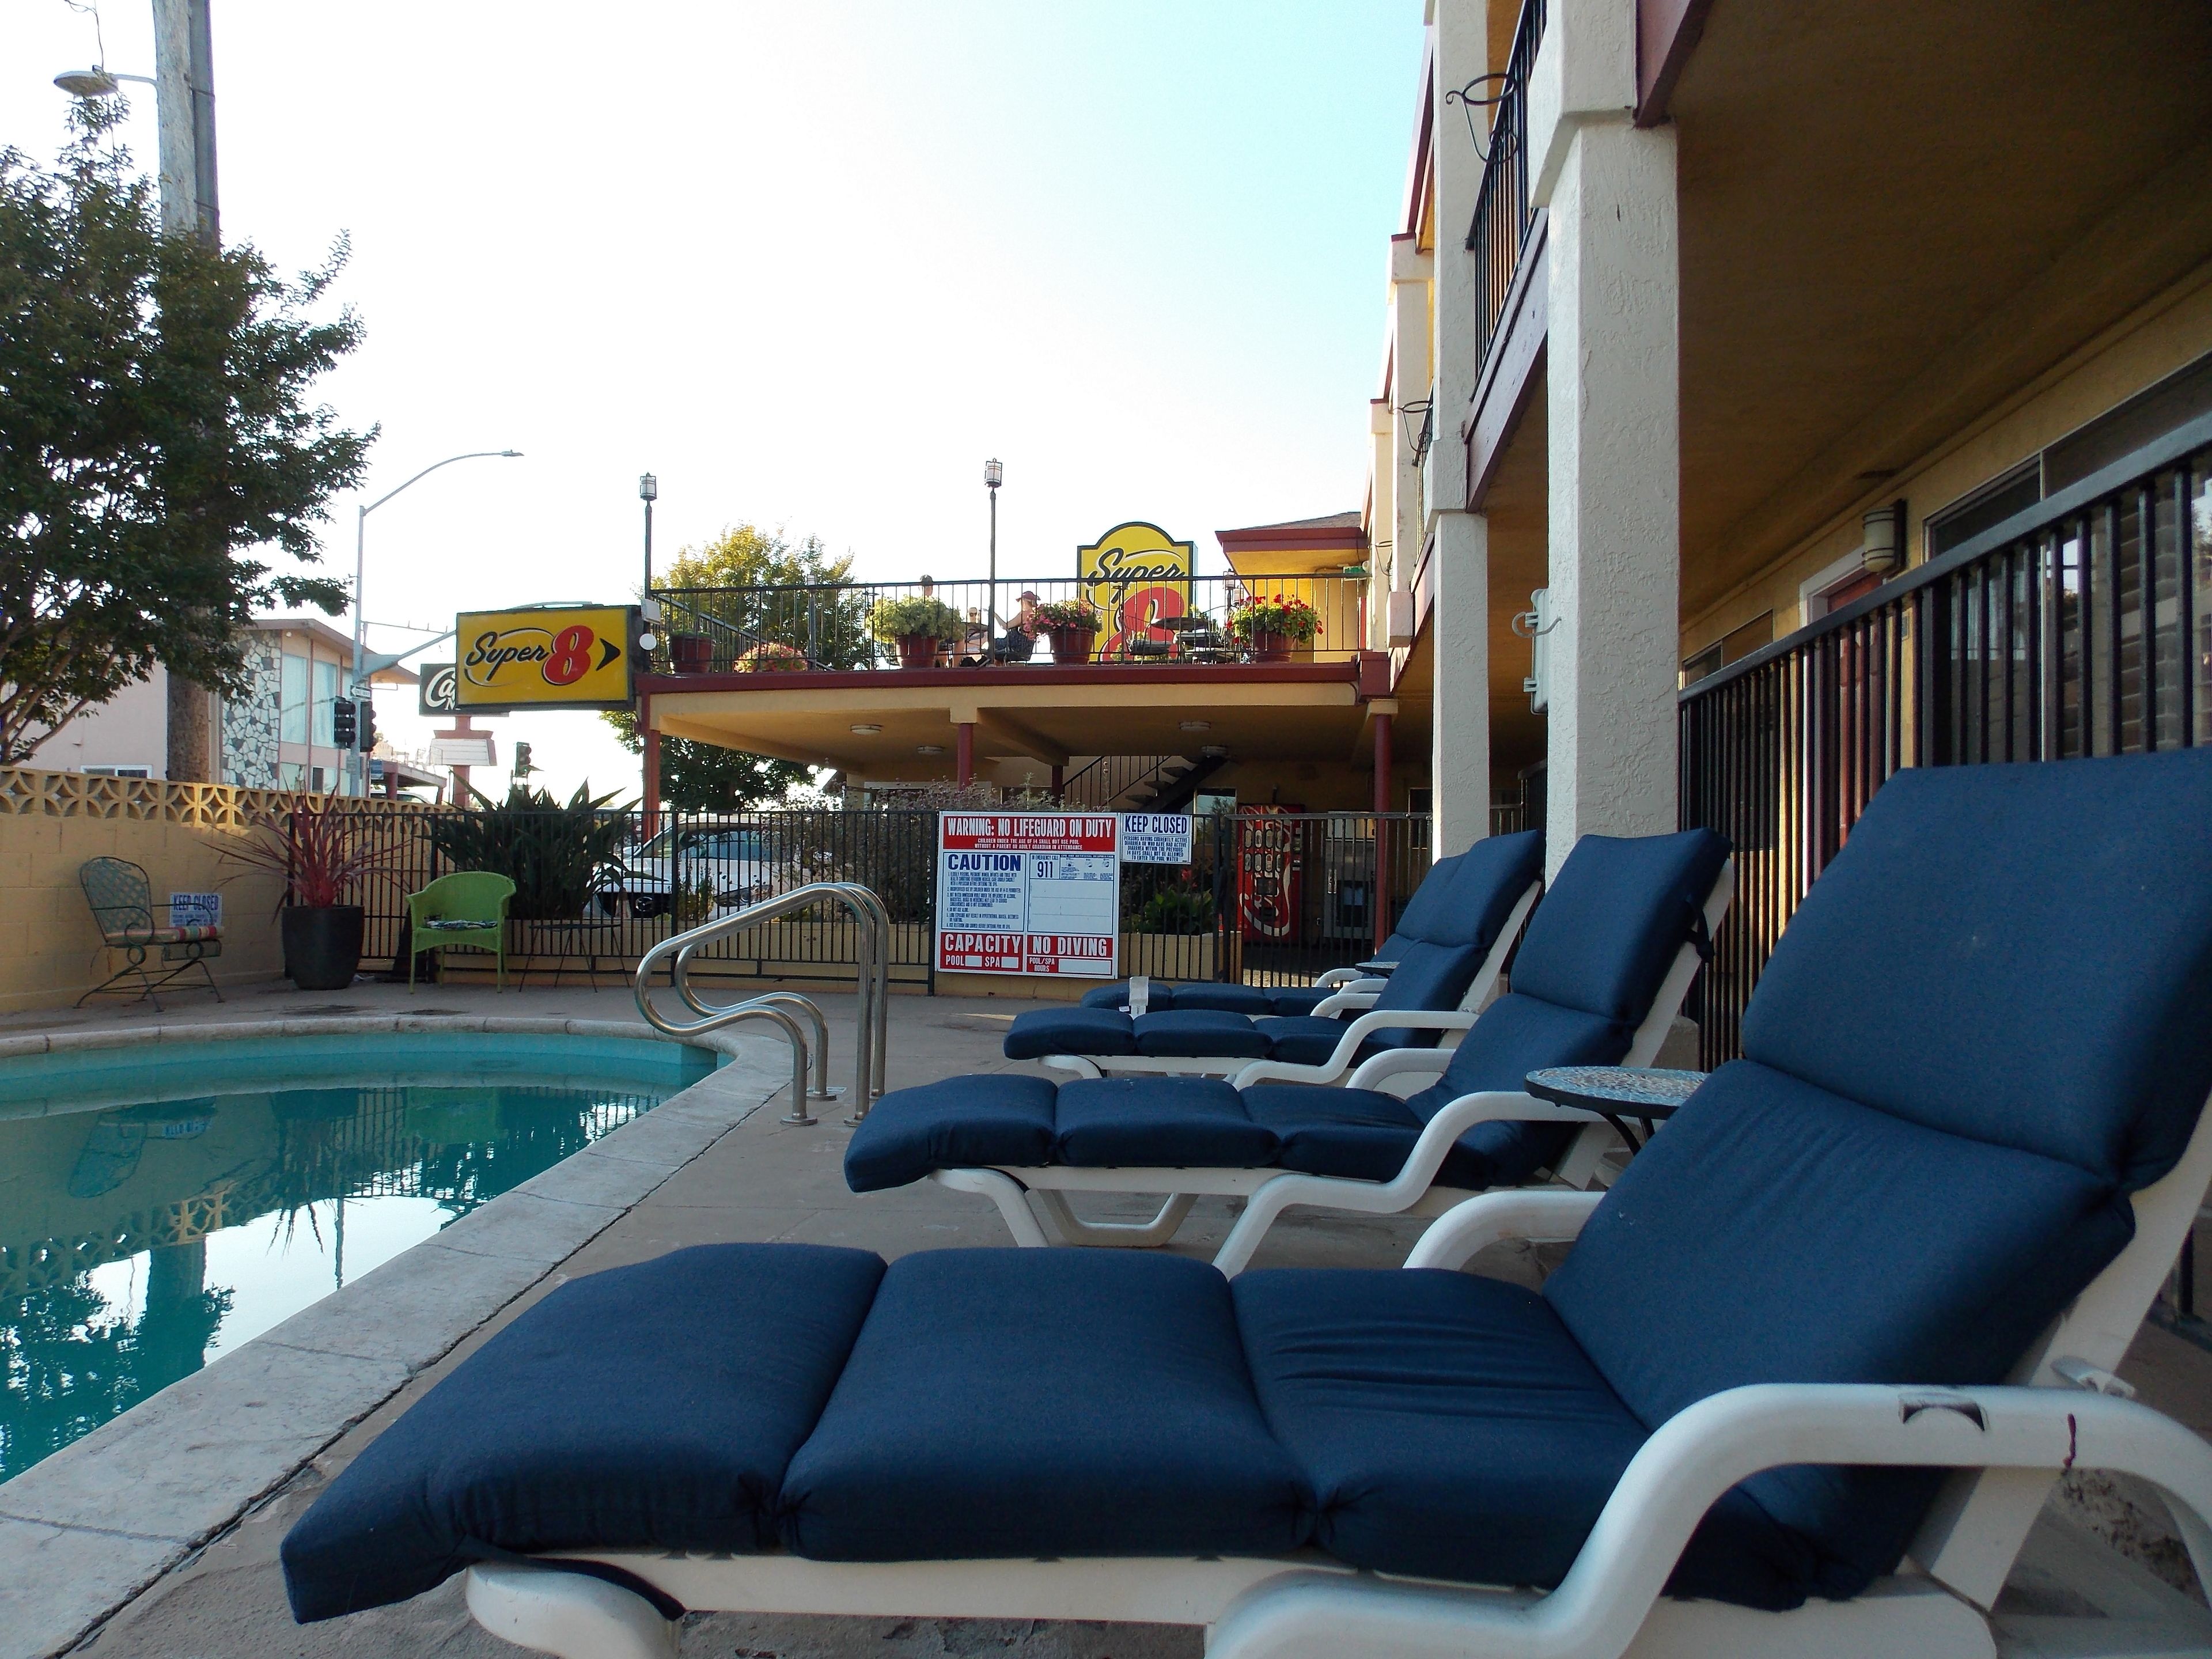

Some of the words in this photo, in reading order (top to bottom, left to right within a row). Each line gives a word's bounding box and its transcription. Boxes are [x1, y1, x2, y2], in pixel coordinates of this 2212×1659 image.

[1086, 548, 1185, 604] Super
[465, 631, 550, 681] Super
[542, 625, 594, 685] 8
[948, 818, 994, 836] WARNING:
[998, 819, 1010, 836] NO
[1014, 819, 1066, 837] LIFEGUARD
[1070, 819, 1082, 838] ON
[1086, 819, 1112, 838] DUTY
[1125, 815, 1149, 833] KEEP
[1152, 816, 1187, 834] CLOSED
[948, 854, 1021, 871] CAUTION
[1037, 861, 1053, 878] 911
[173, 895, 192, 911] KEEP
[194, 895, 219, 911] CLOSED
[945, 934, 1021, 953] CAPACITY
[1033, 936, 1051, 954] NO
[1058, 938, 1107, 956] DIVING
[946, 955, 964, 966] POOL
[984, 956, 1000, 968] SPA
[1029, 957, 1055, 965] POOL/SPA
